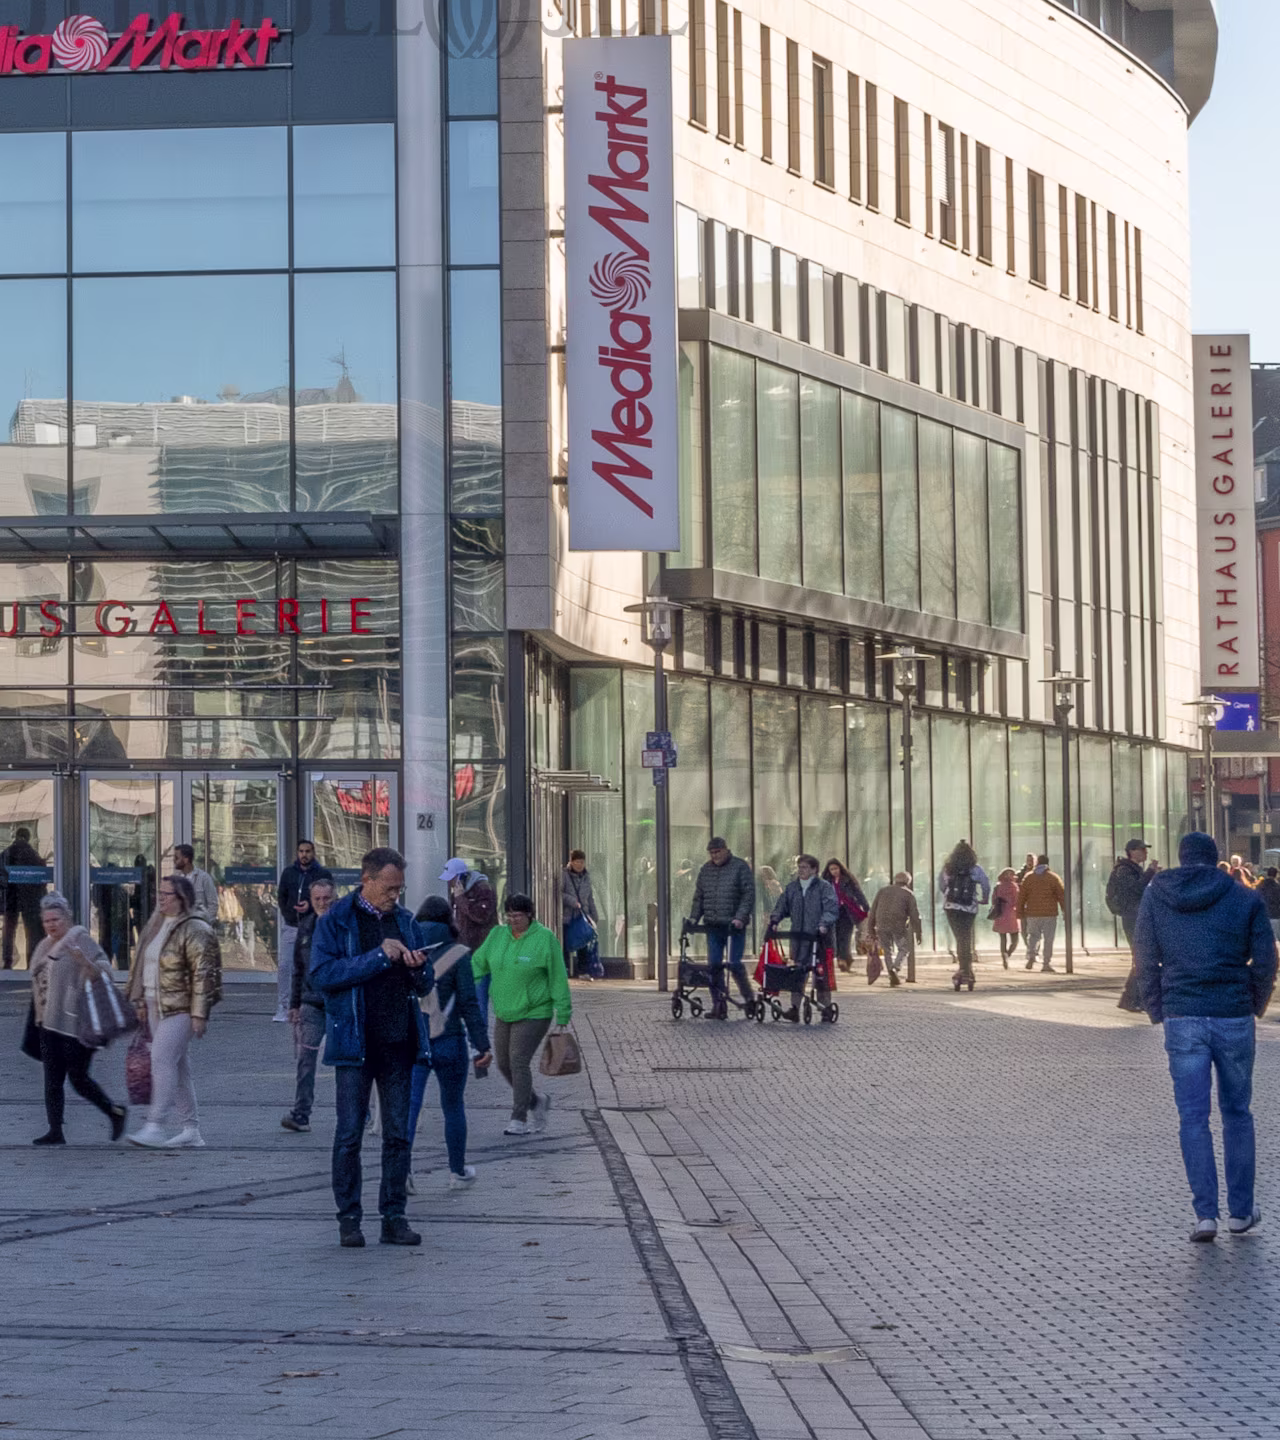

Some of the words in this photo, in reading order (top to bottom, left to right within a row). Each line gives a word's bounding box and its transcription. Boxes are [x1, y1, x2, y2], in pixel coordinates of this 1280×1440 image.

[1209, 344, 1236, 495] GALERIE
[94, 597, 373, 637] GALERIE
[1213, 511, 1240, 677] RATHAUS
[418, 814, 433, 829] 26
